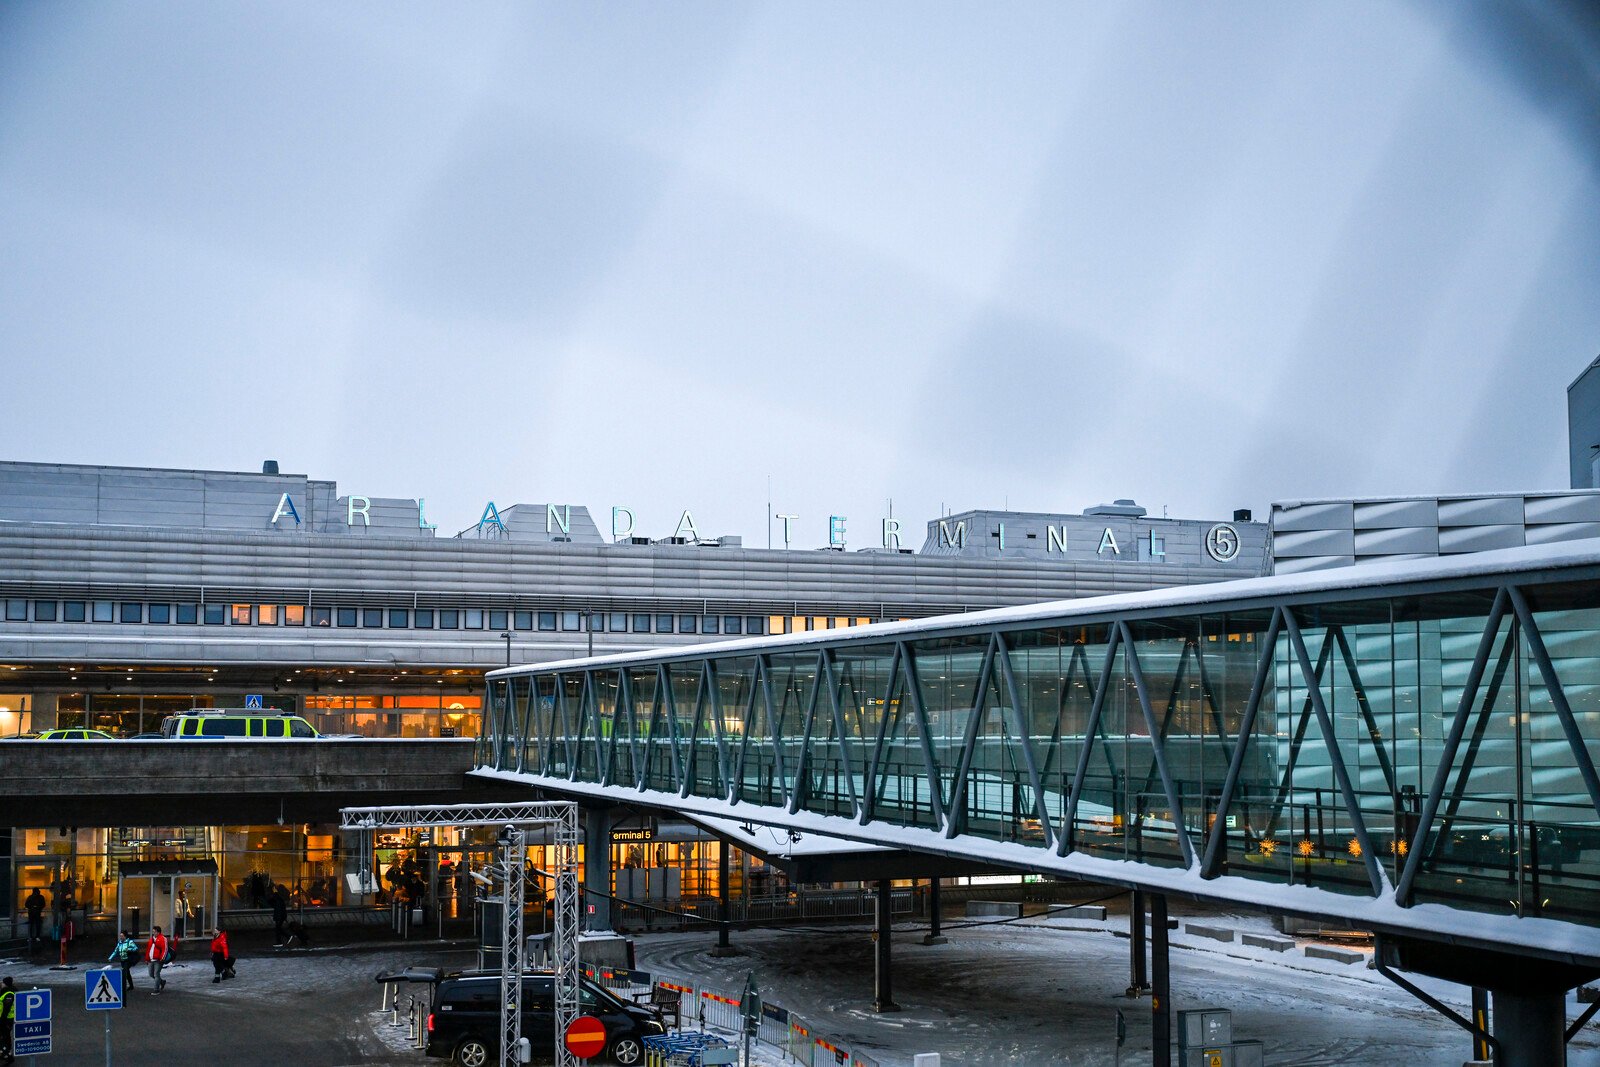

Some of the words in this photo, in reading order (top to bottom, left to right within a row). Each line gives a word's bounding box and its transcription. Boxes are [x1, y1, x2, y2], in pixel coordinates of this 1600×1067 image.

[271, 492, 698, 539] ARLANDA
[775, 514, 1166, 556] TERMINAL
[612, 831, 644, 839] erminal
[645, 831, 651, 839] 5
[27, 994, 43, 1018] P
[24, 1025, 42, 1033] TAXI
